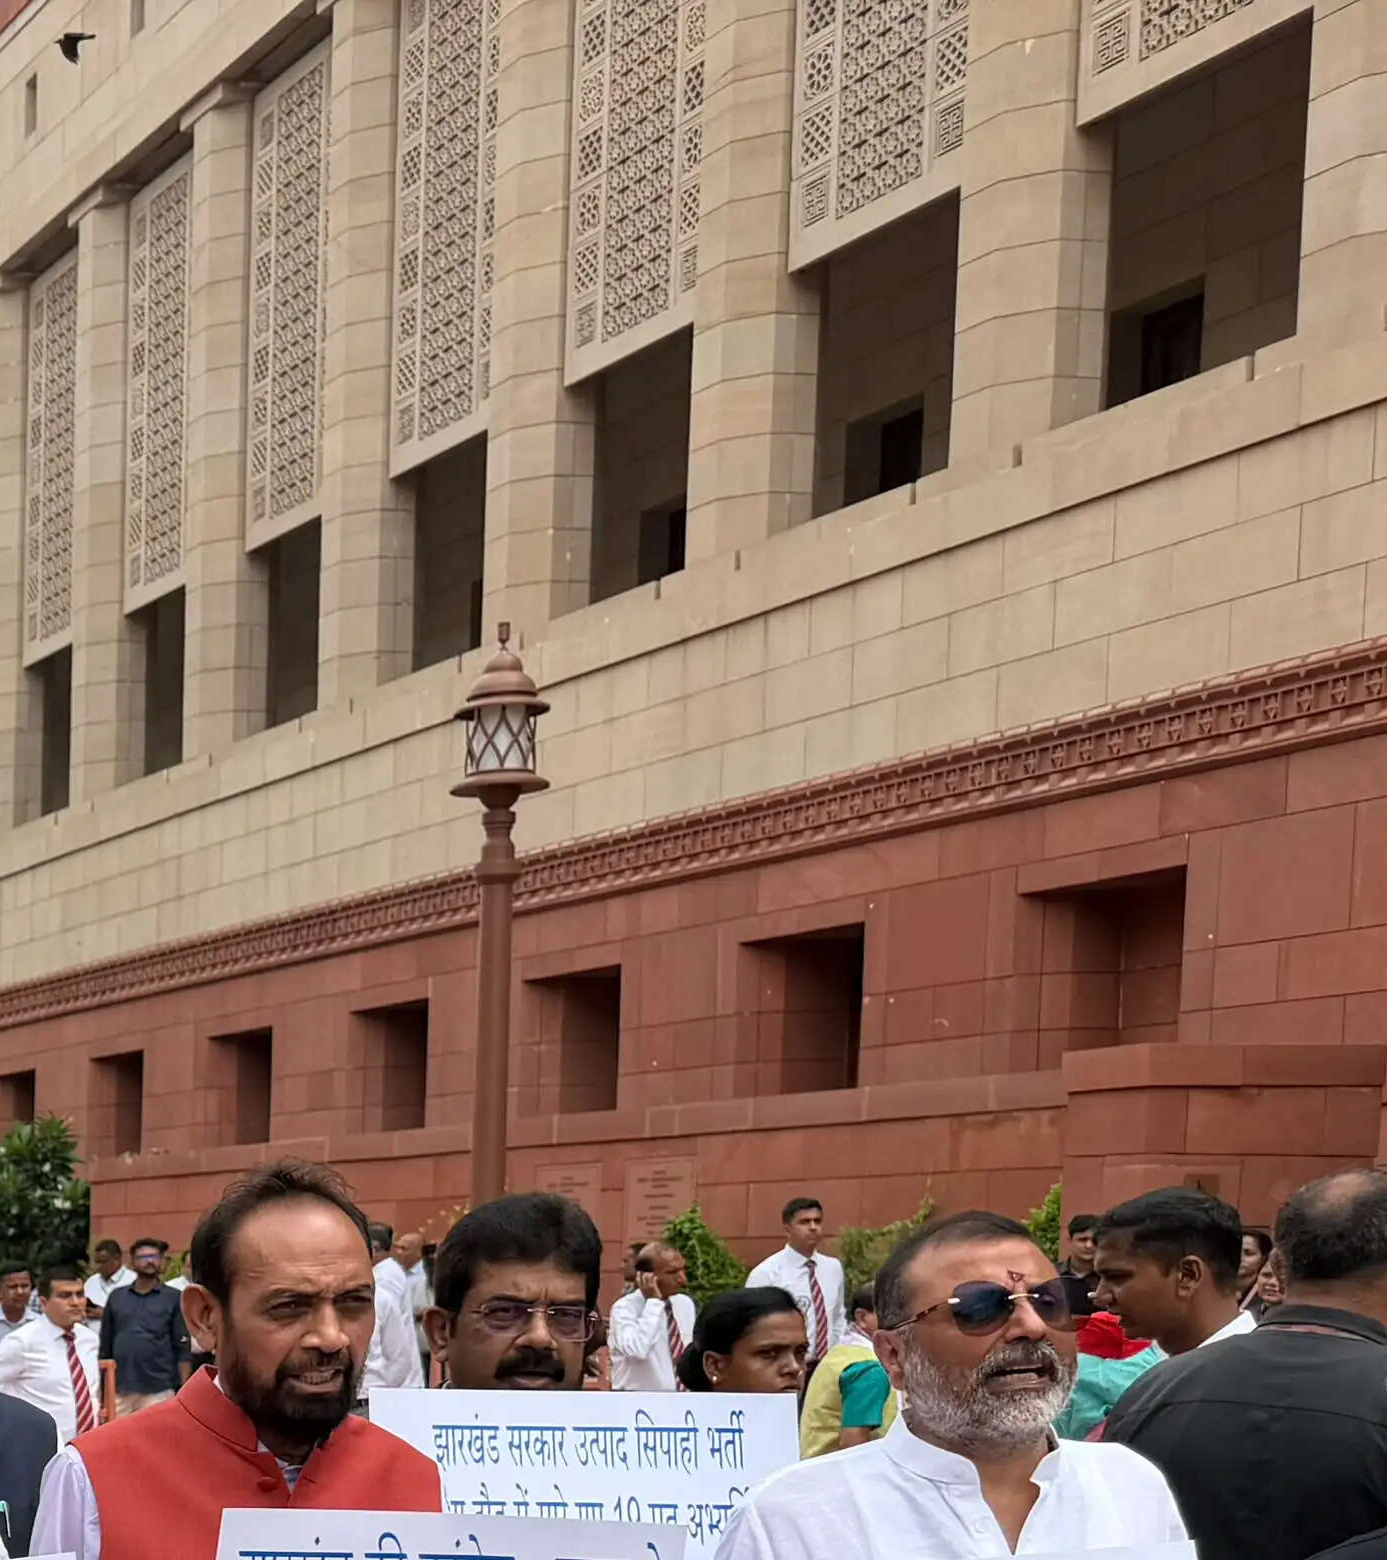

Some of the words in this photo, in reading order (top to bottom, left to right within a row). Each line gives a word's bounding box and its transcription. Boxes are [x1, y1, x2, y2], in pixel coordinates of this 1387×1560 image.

[432, 1413, 499, 1472] झारखंड
[506, 1426, 568, 1467] सरकार
[572, 1427, 629, 1470] उत्पाद
[634, 1409, 699, 1474] सिपाही
[707, 1410, 745, 1469] भर्ती
